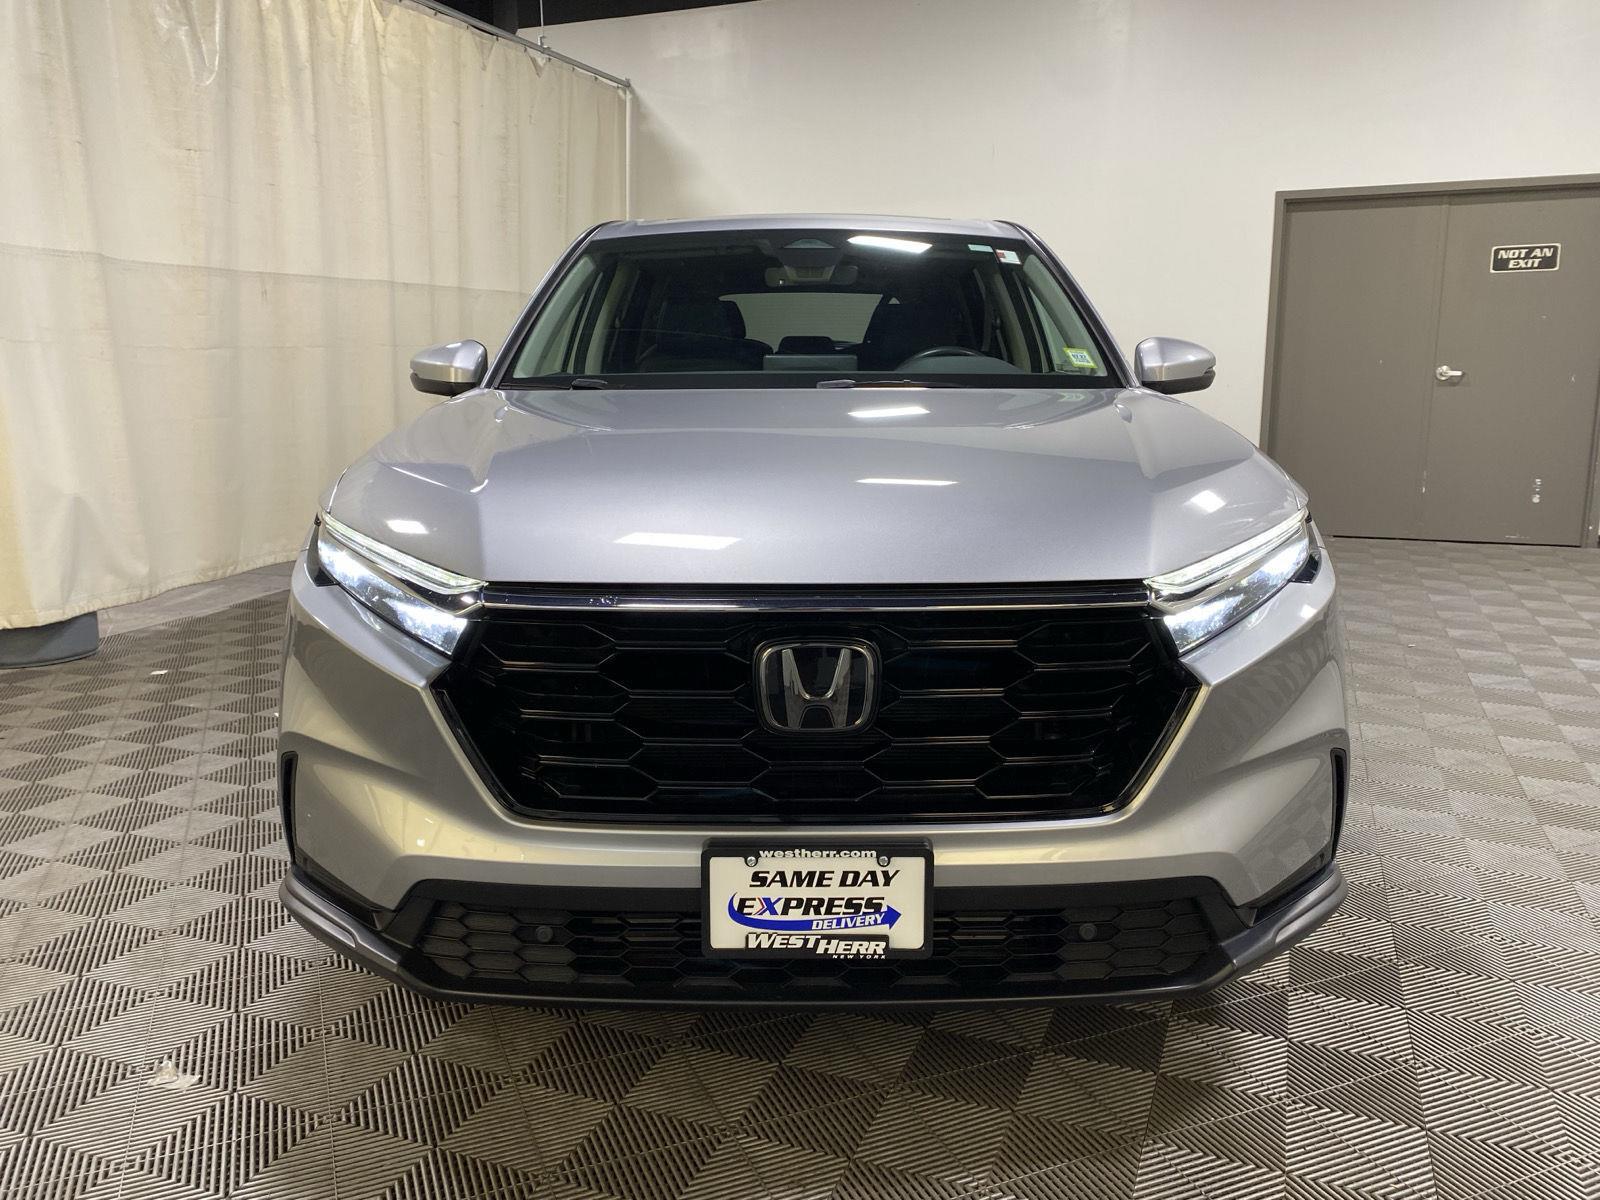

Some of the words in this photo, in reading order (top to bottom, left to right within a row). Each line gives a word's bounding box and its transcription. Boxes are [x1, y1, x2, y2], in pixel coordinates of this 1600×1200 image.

[1498, 249, 1529, 259] NOT
[1530, 248, 1554, 258] AN
[1508, 258, 1542, 269] EXIT
[759, 849, 877, 858] westherr.com
[749, 870, 834, 888] SAME
[838, 869, 901, 888] DAY
[736, 896, 885, 916] EXPRESS
[811, 912, 885, 931] DELIVERY
[746, 933, 822, 949] WEST
[815, 939, 887, 955] HERR
